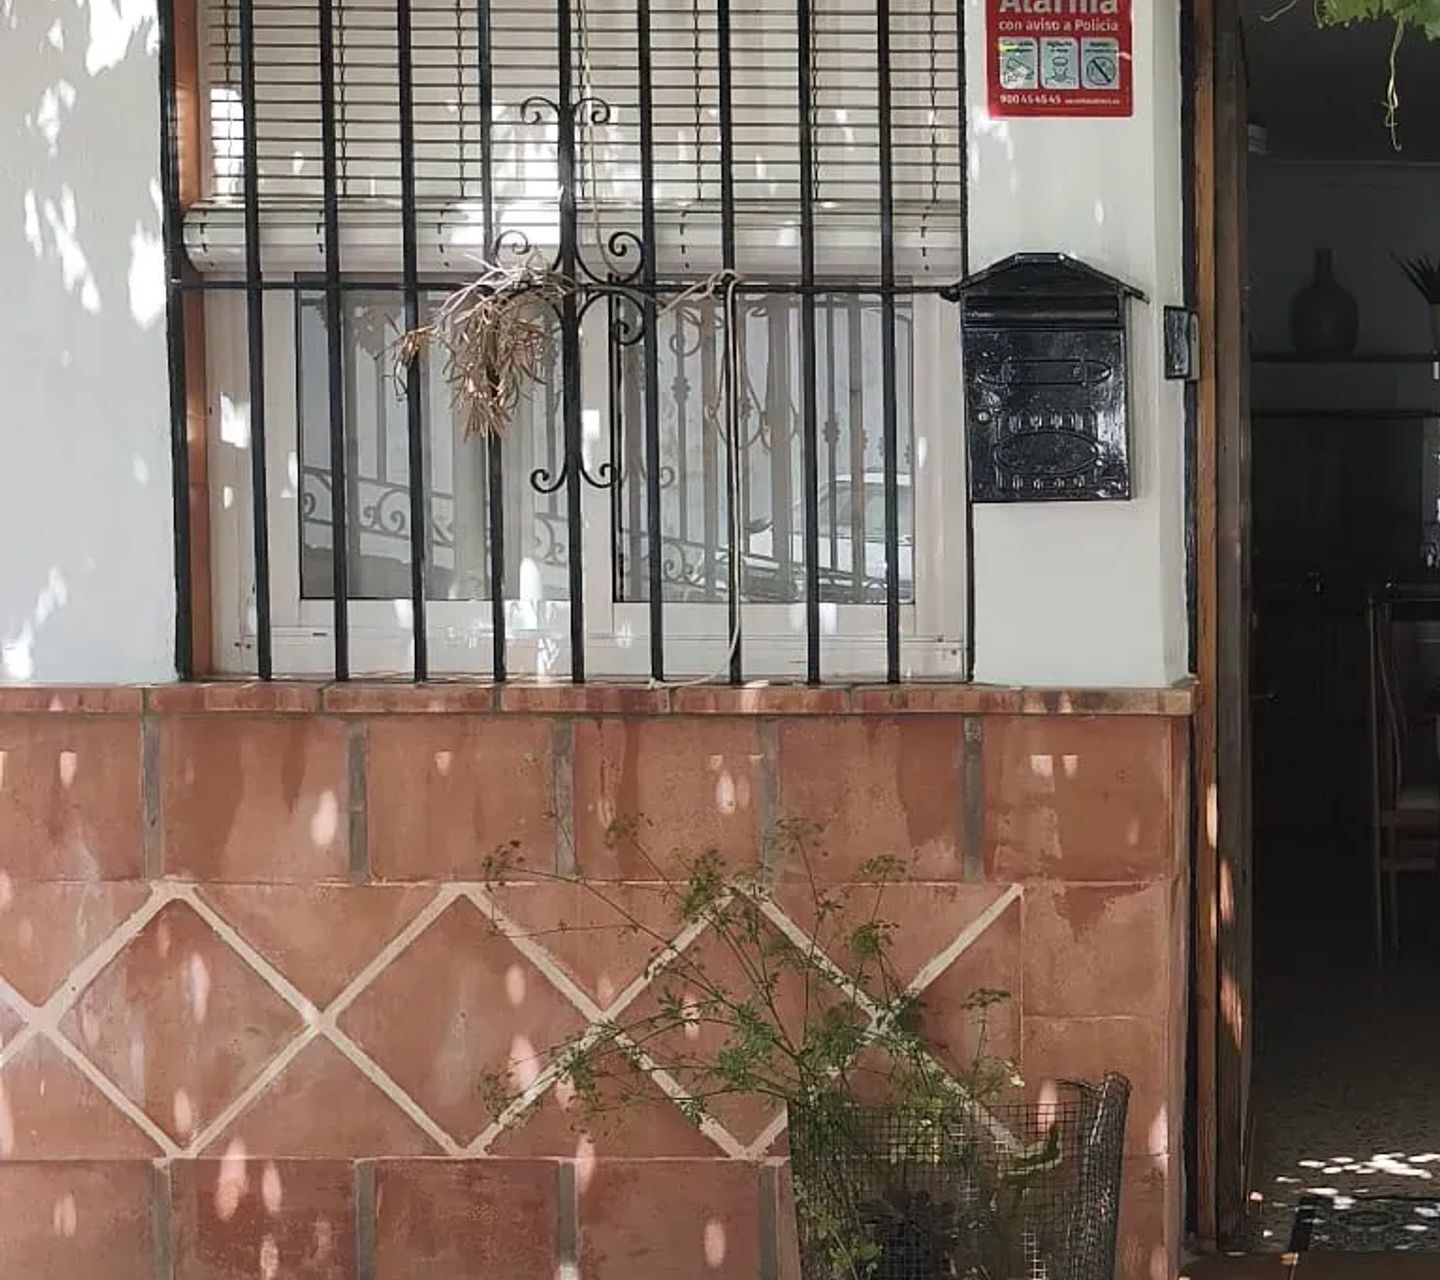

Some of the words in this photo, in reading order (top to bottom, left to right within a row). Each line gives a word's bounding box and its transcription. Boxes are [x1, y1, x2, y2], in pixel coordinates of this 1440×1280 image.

[998, 19, 1022, 32] con
[1025, 17, 1061, 32] aviso
[1063, 20, 1072, 32] a
